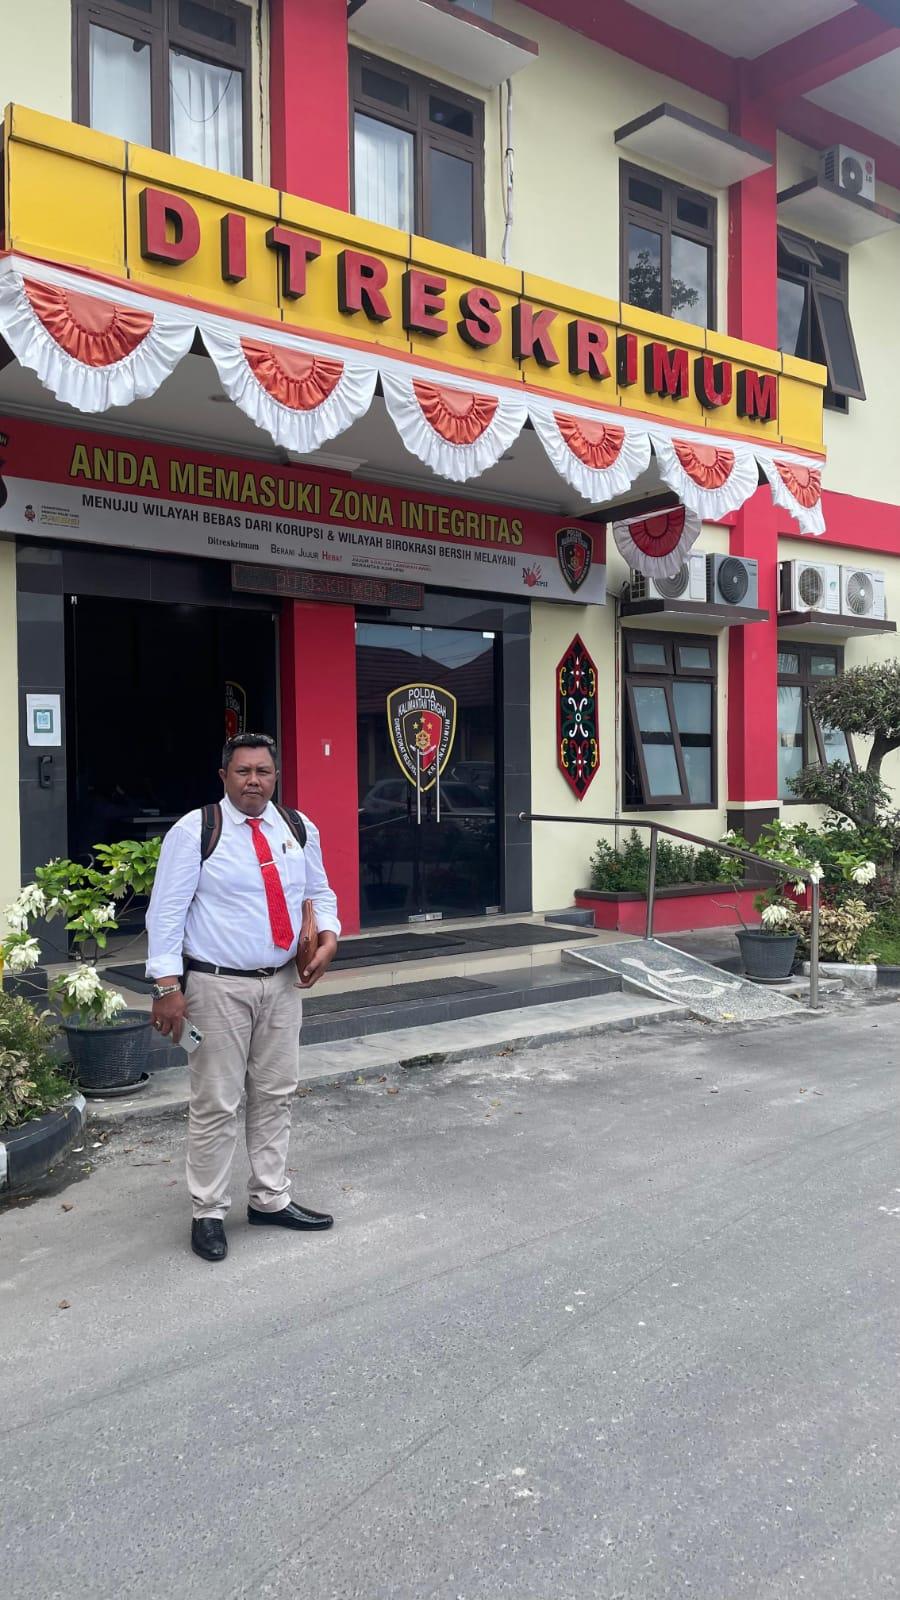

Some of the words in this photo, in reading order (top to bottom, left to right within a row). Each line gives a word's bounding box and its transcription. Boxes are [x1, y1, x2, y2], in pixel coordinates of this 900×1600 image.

[139, 187, 778, 423] DITRESKRIMUM
[69, 443, 160, 490] ANDA
[169, 460, 321, 515] MEMASUKI
[328, 487, 394, 527] ZONA
[401, 500, 524, 546] INTEGRITAS
[82, 494, 139, 513] MENUJU
[143, 503, 199, 522] WILAYAH
[203, 512, 242, 528] BEBAS
[245, 518, 272, 532] DARI
[275, 523, 324, 540] KORUPSI
[327, 530, 335, 542] &
[338, 531, 383, 549] WILAYAH
[386, 539, 437, 557] BIROKRASI
[439, 546, 472, 561] BERSIH
[474, 551, 517, 568] MELAYANI
[207, 536, 260, 551] Ditreskrimum
[398, 699, 427, 717] KALIMANTAN
[427, 699, 447, 718] TENGAH
[408, 688, 436, 700] POLDA
